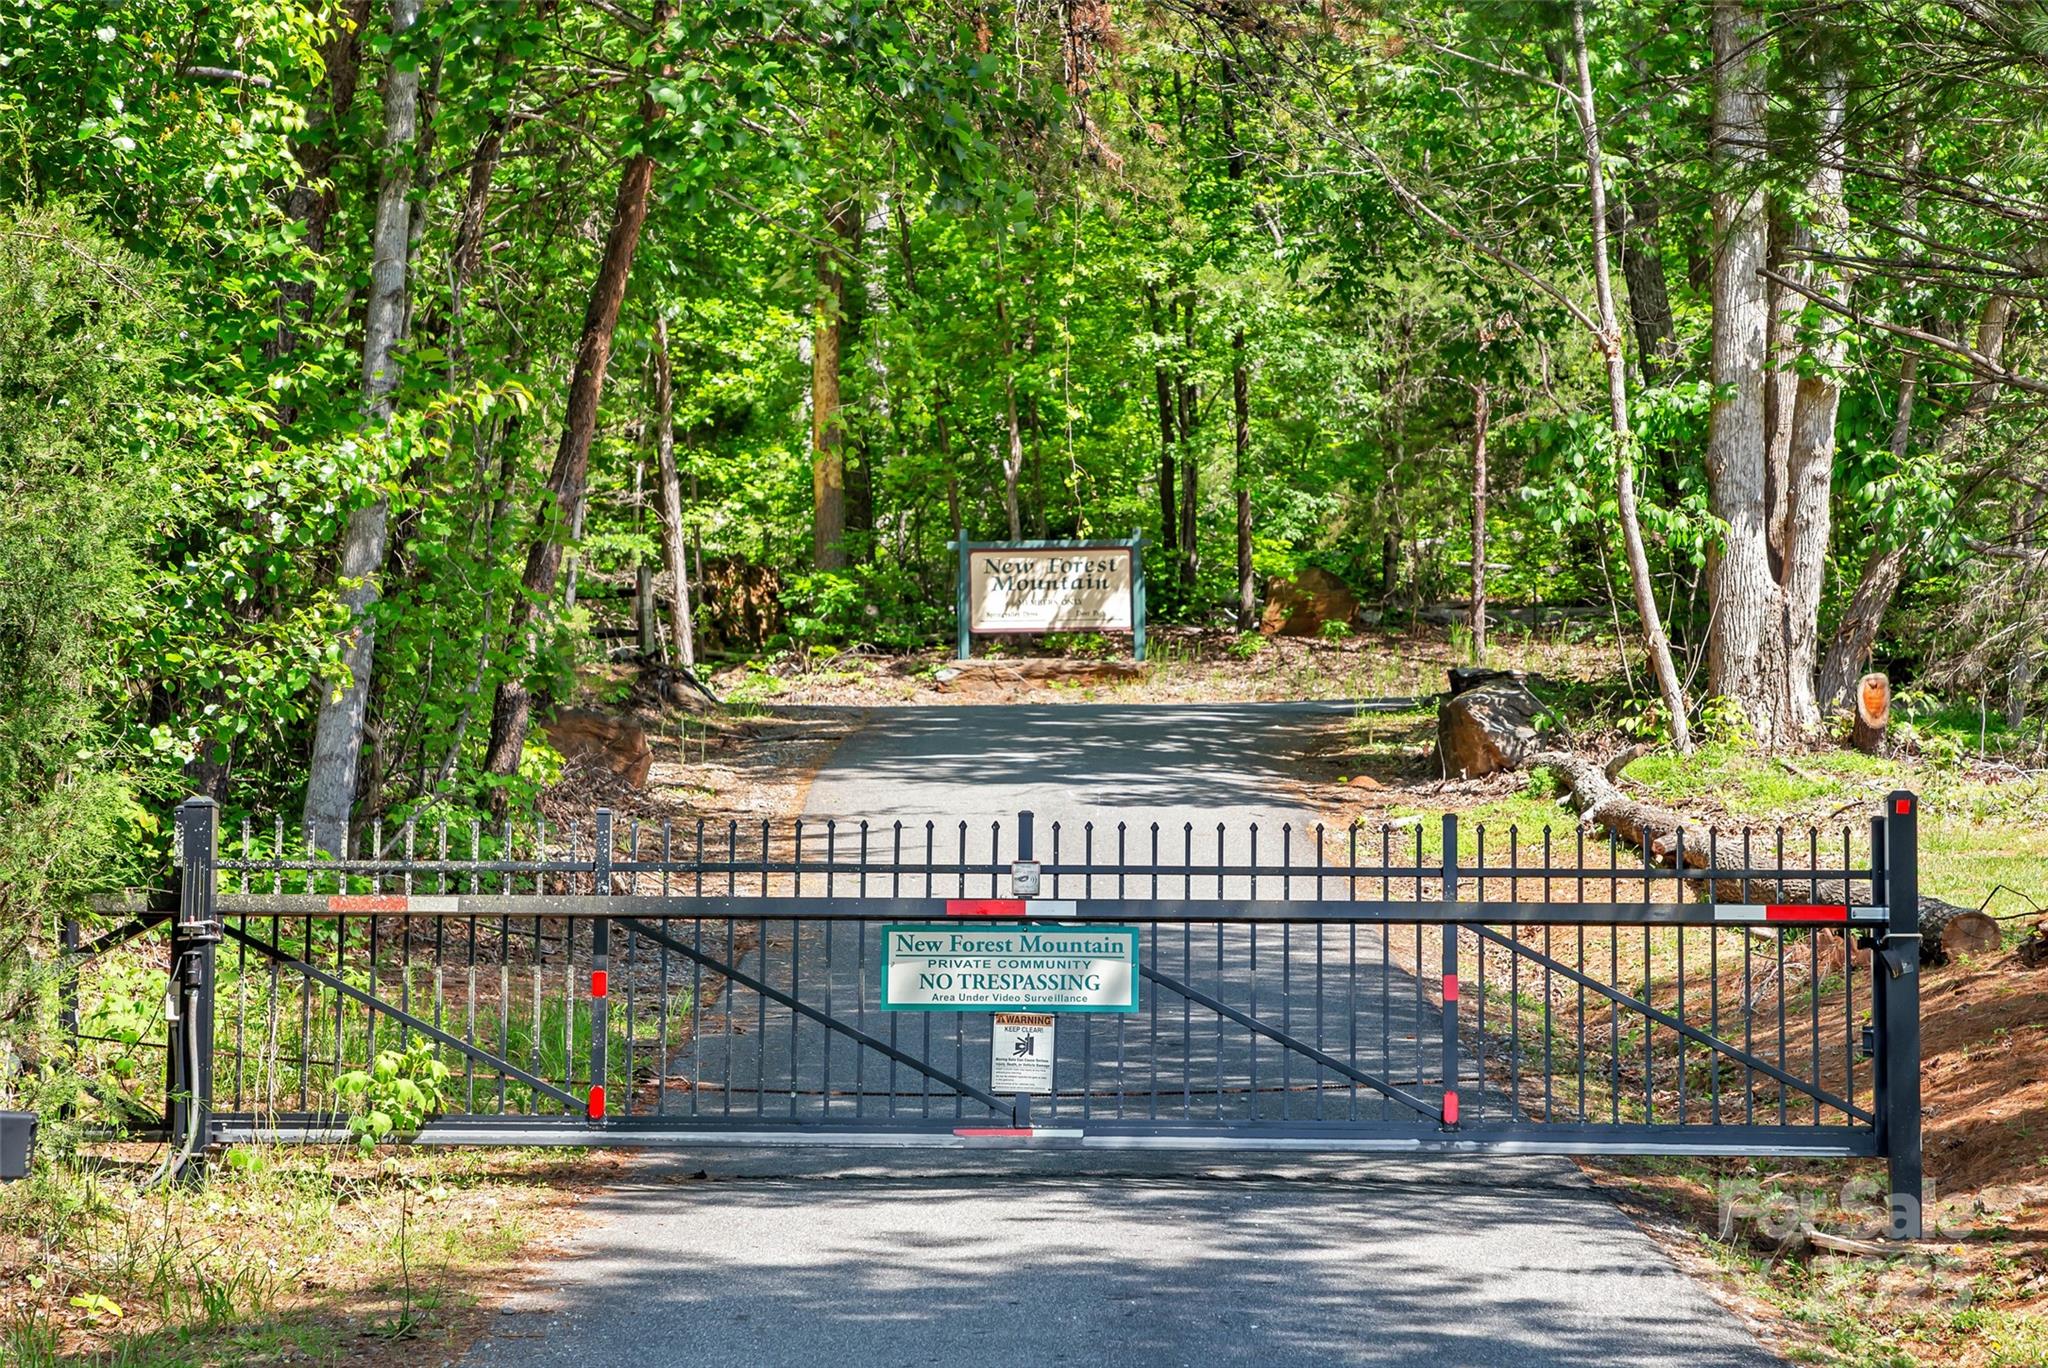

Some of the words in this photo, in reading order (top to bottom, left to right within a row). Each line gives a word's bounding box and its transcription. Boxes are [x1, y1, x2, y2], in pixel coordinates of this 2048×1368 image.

[983, 558, 1034, 574] New
[1048, 557, 1117, 574] Forest
[992, 574, 1110, 591] Mountain
[896, 934, 943, 953] New
[949, 934, 1013, 953] Forest
[1019, 935, 1124, 953] Mountain
[928, 960, 991, 968] PRIVATE
[998, 960, 1092, 970] COMMUNITY
[920, 973, 952, 990] NO
[957, 973, 1101, 991] TRESPASSING
[932, 994, 955, 1002] Area
[959, 994, 989, 1002] Under
[993, 994, 1020, 1002] Video
[1024, 994, 1088, 1003] Surveillance
[1006, 1015, 1051, 1025] WARNING
